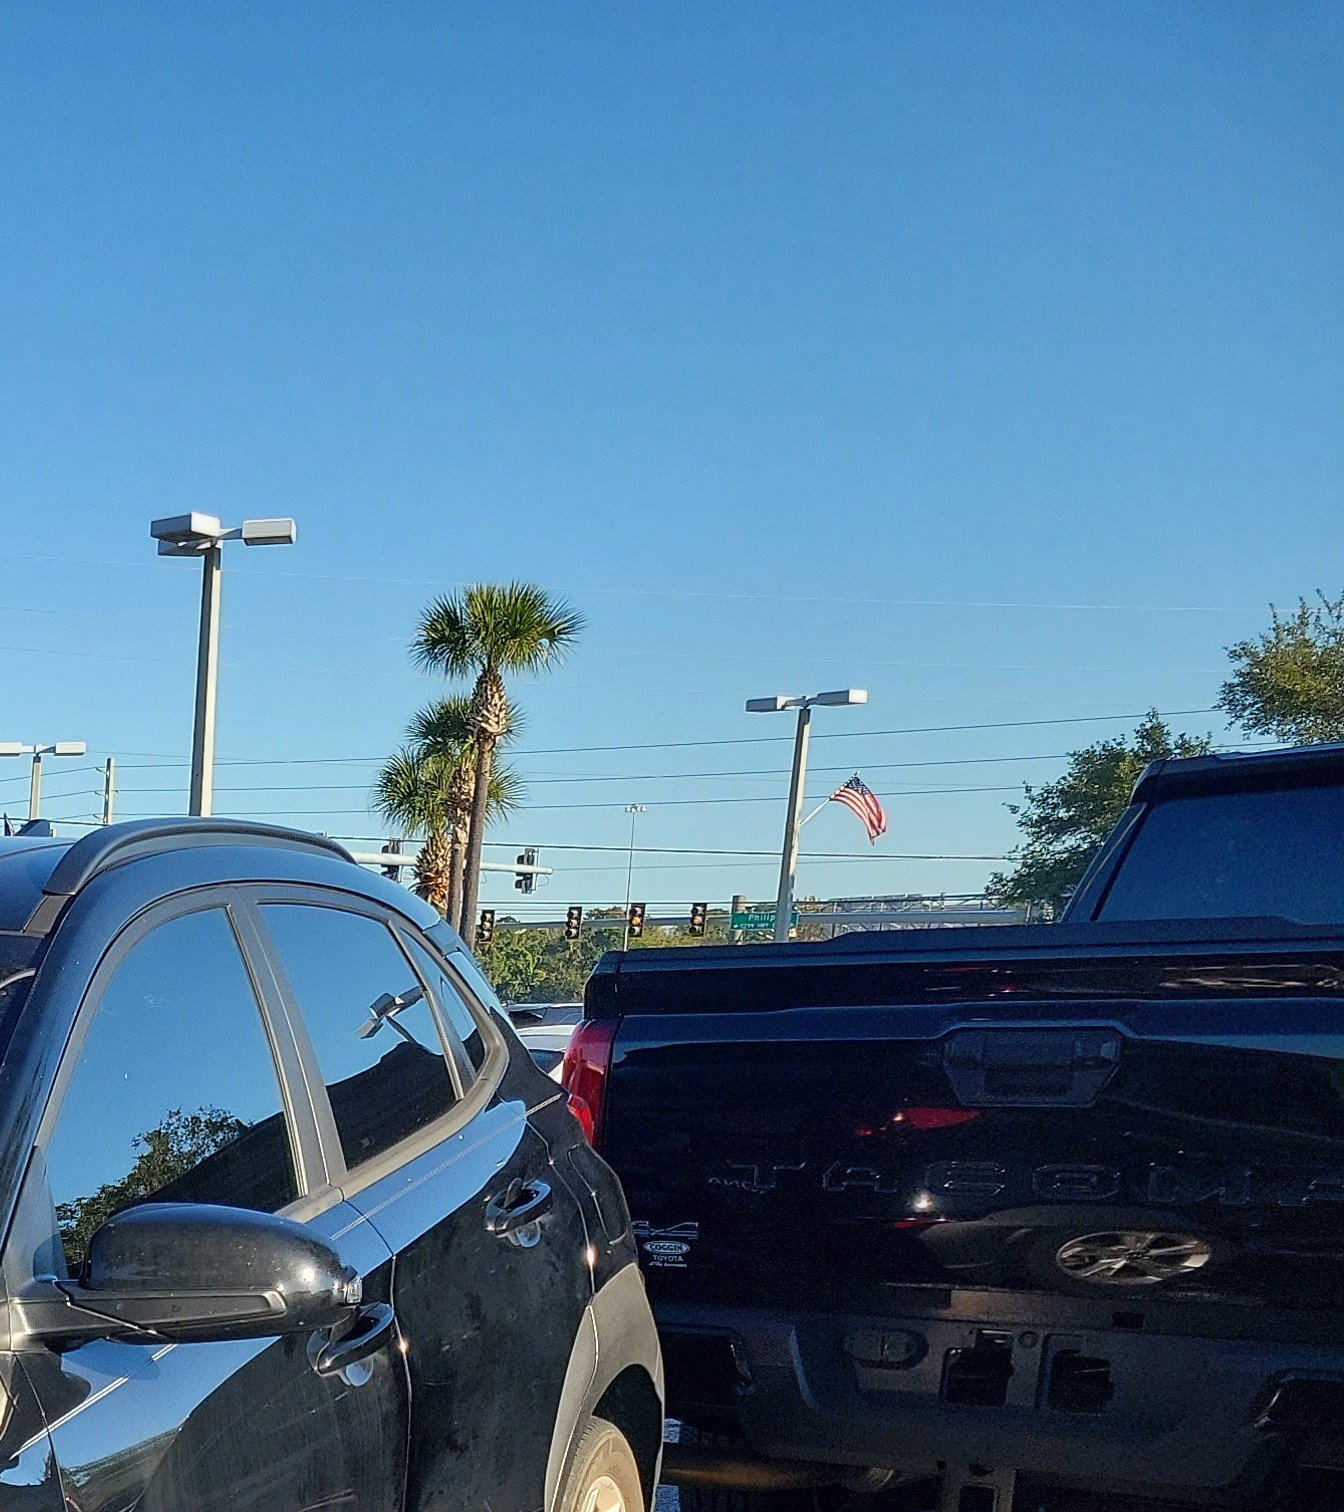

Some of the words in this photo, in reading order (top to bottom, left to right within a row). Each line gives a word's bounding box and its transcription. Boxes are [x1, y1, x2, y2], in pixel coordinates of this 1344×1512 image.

[748, 914, 777, 922] Philip
[649, 1243, 684, 1252] COGGIN
[652, 1254, 684, 1262] TOYOTA
